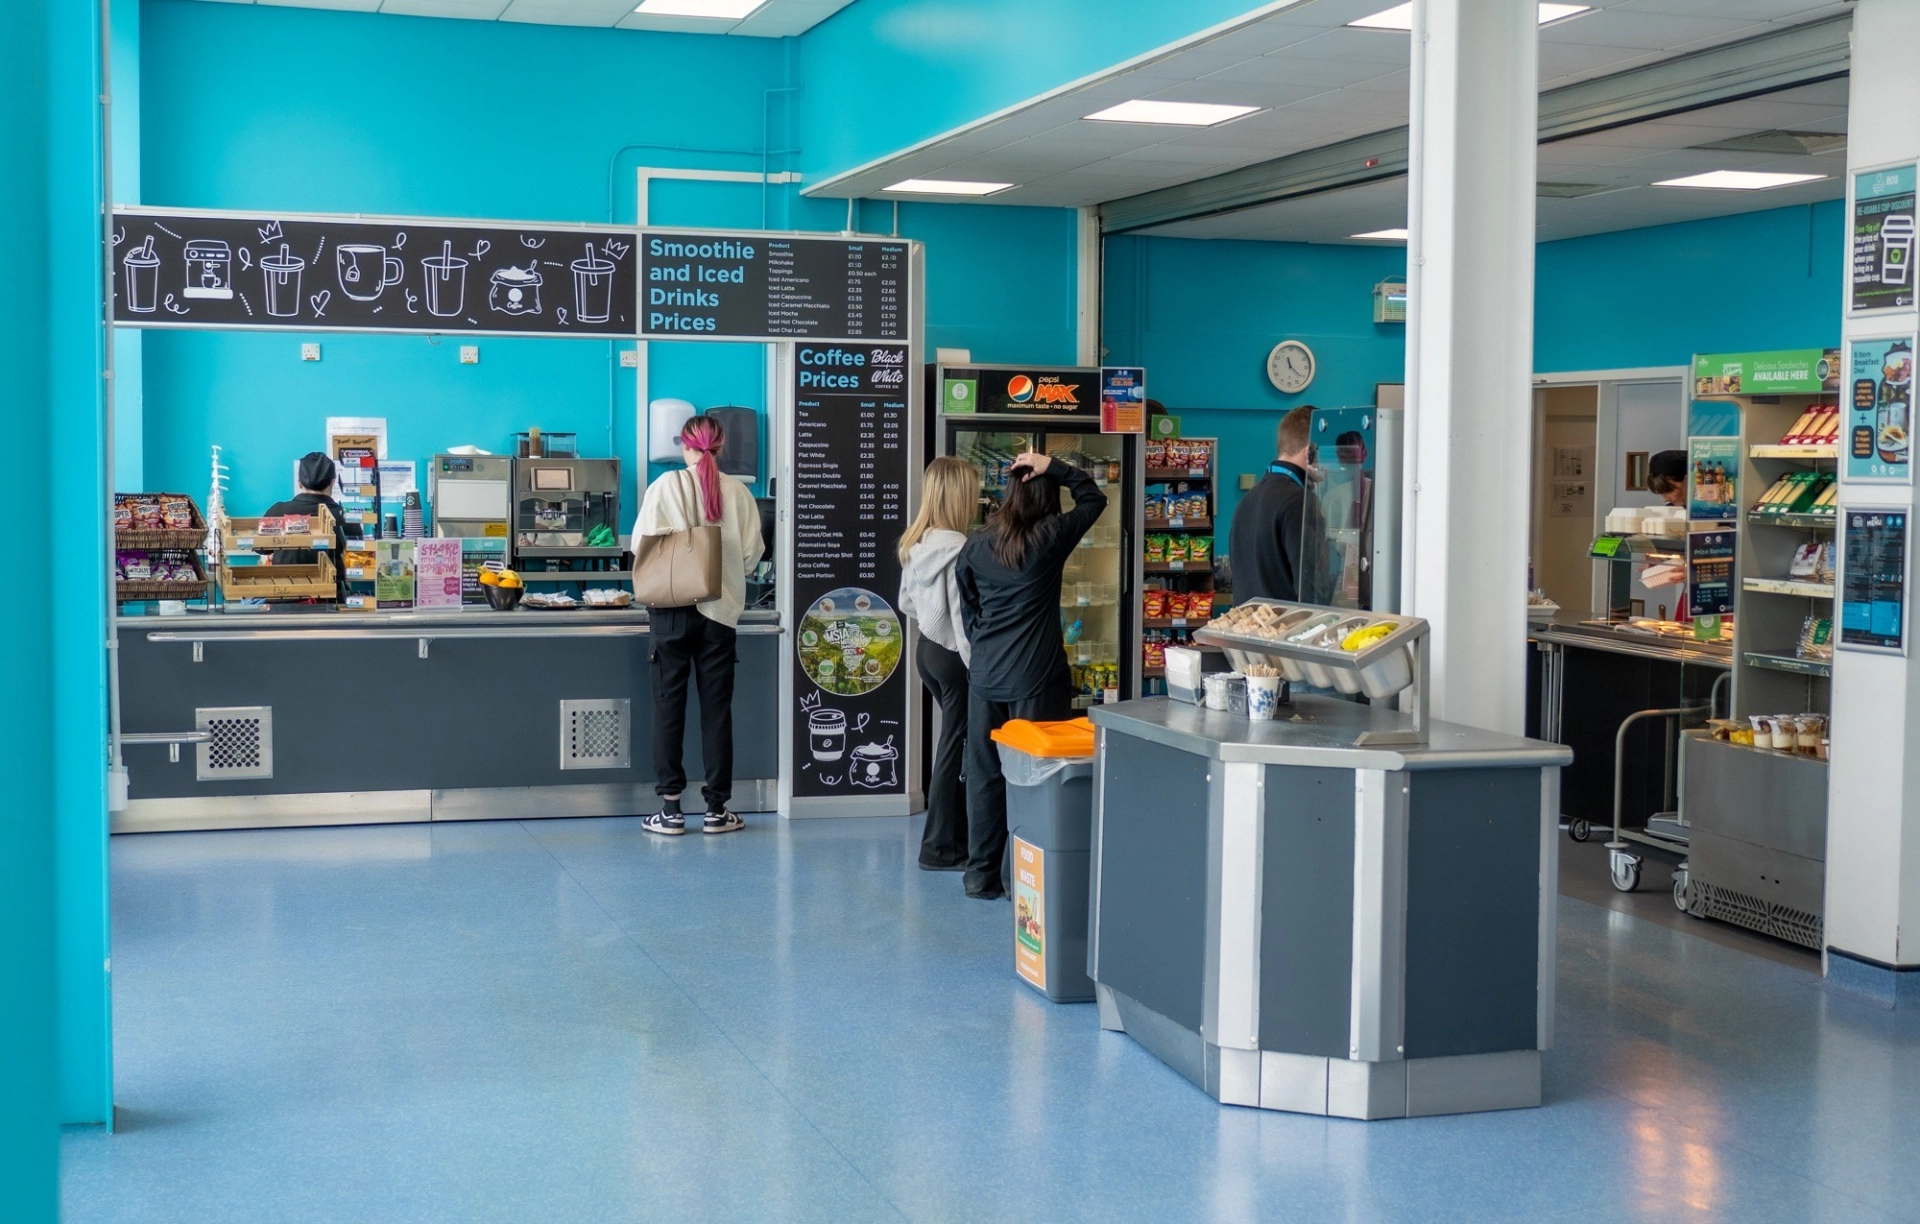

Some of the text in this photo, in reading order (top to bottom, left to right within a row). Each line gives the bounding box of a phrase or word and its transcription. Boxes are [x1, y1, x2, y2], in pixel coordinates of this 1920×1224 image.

[650, 239, 754, 259] Smoothie
[650, 264, 744, 283] and Iced
[651, 288, 719, 307] Drinks
[651, 312, 716, 331] Prices
[800, 349, 865, 366] Coffee
[871, 349, 904, 364] Black
[1754, 360, 1808, 371] Delicious Sandwiches
[800, 371, 859, 388] Prices
[871, 369, 904, 383] White
[1753, 370, 1808, 382] AVAILABLE HERE
[1034, 384, 1080, 403] MAX
[1694, 442, 1711, 450] Meal
[1866, 519, 1882, 527] MENU
[421, 544, 458, 558] SHAKE
[1021, 847, 1034, 863] FOOD
[1020, 868, 1036, 887] WASTE
